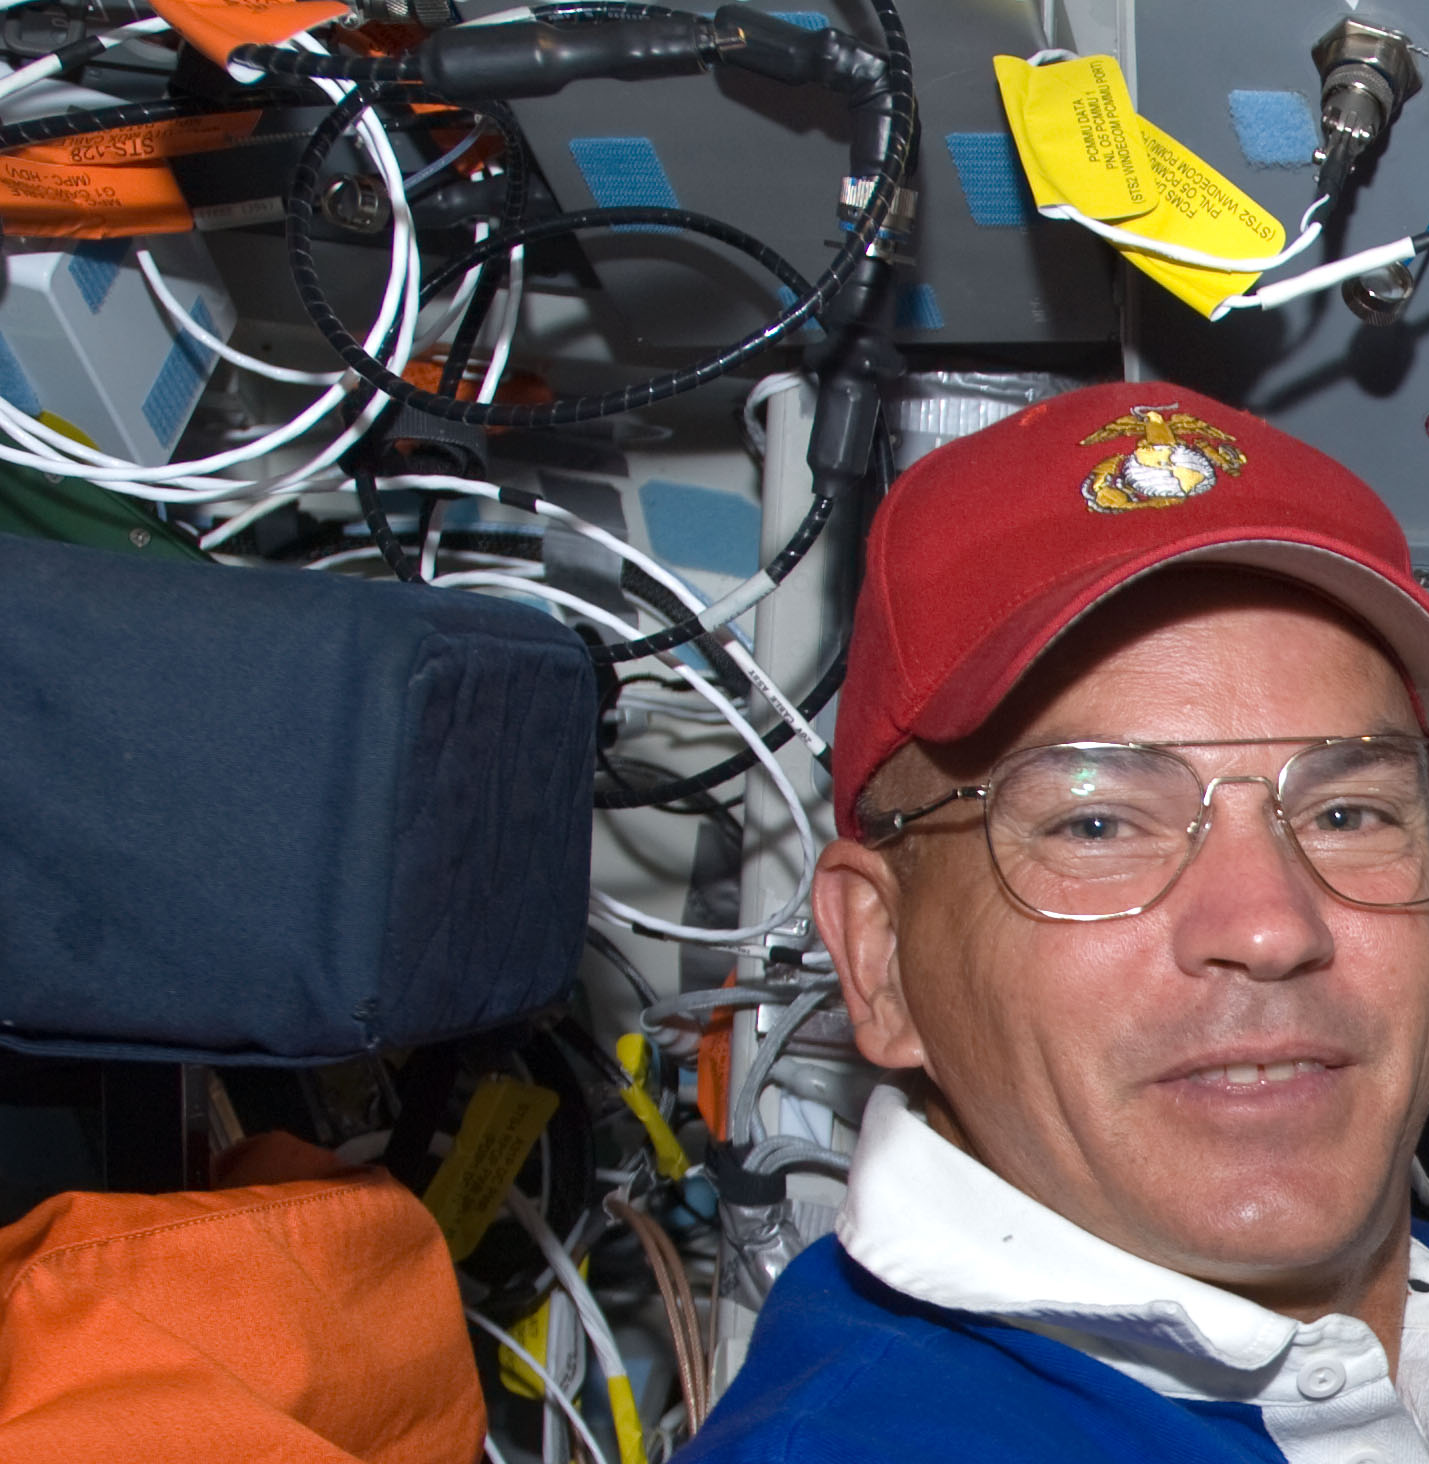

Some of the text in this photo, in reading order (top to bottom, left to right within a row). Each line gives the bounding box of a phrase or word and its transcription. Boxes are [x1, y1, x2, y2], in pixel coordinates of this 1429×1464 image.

[1073, 99, 1090, 125] DATA
[70, 137, 155, 163] STS-128
[1101, 149, 1116, 170] PNL
[1126, 177, 1145, 204] (STS2
[1177, 162, 1239, 214] WINDECOM
[1165, 190, 1198, 219] FCMS
[1199, 196, 1222, 220] PNL
[1239, 209, 1276, 242] (STS2
